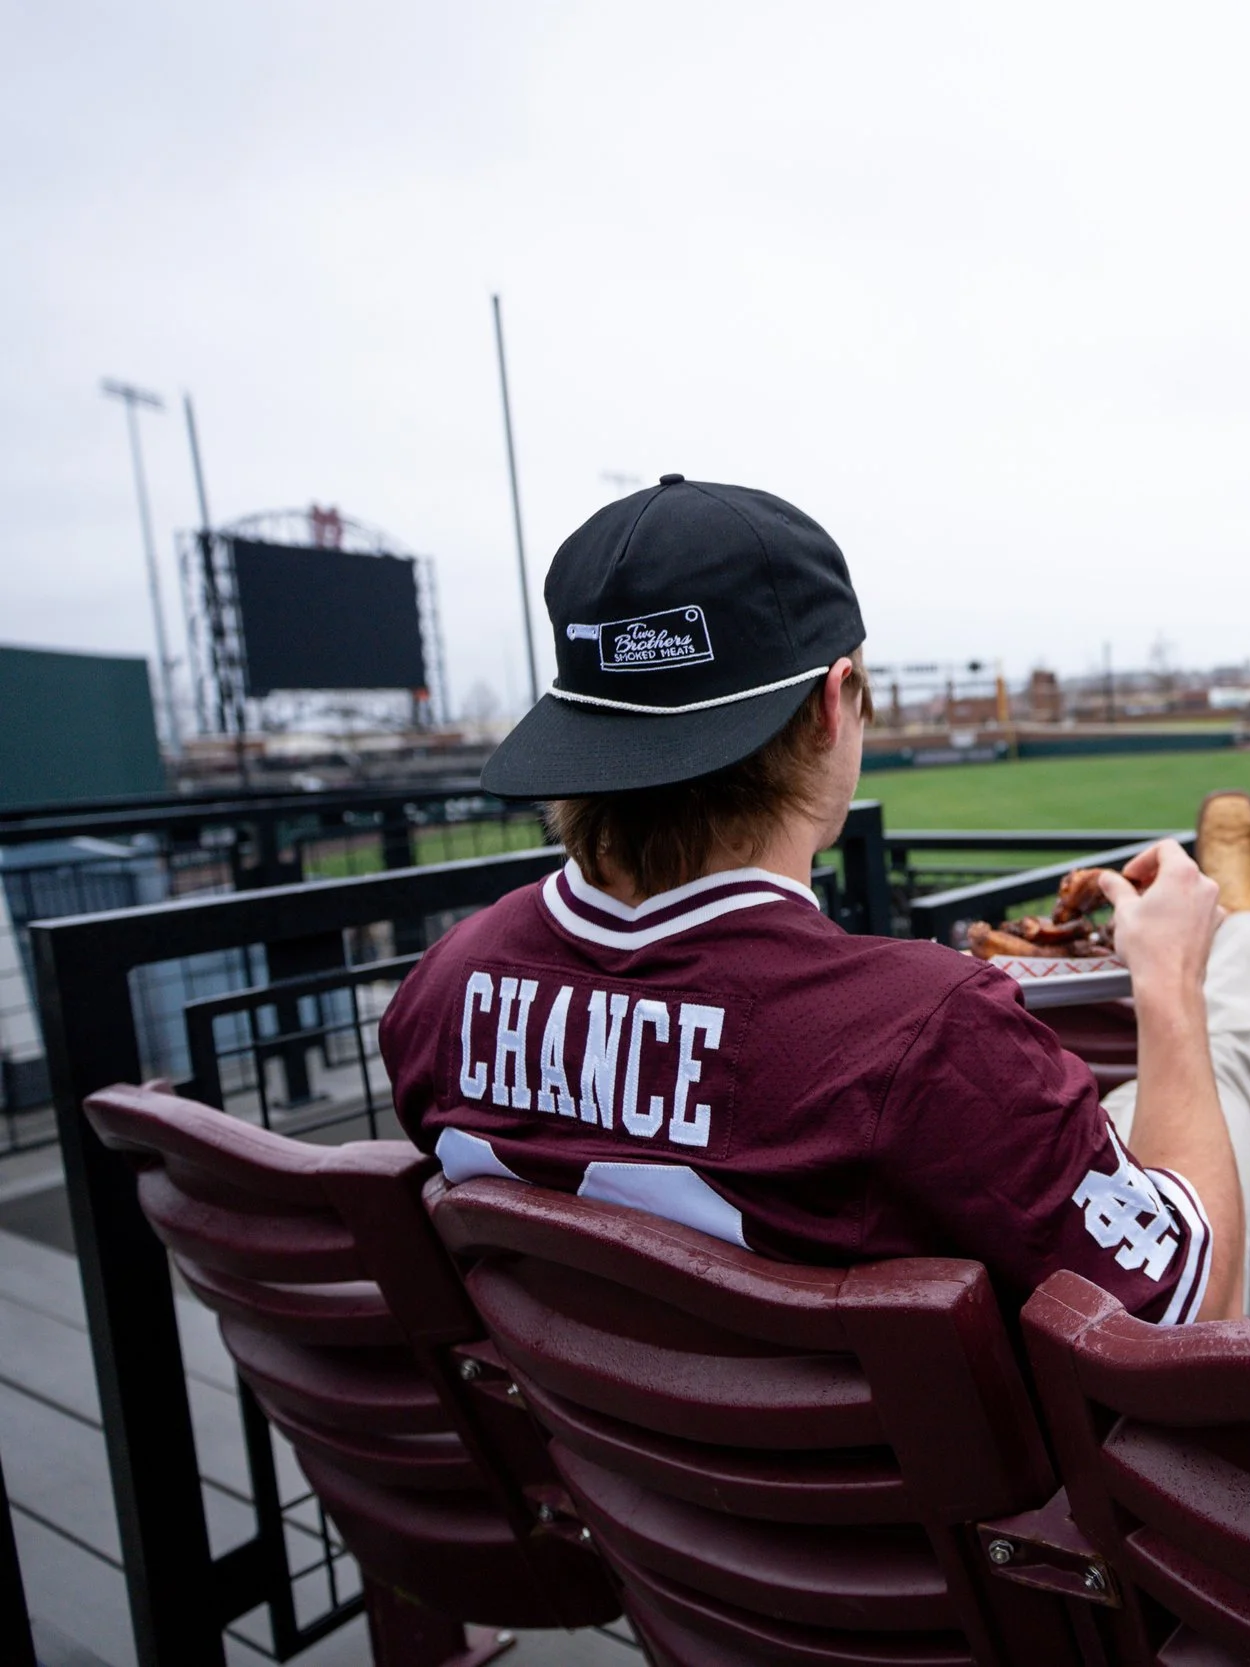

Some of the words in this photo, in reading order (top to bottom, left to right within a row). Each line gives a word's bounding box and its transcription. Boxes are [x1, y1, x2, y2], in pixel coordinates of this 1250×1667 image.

[614, 629, 692, 654] Brothers
[627, 623, 655, 640] Two
[614, 650, 656, 663] SMOKED
[660, 645, 695, 658] MEATS
[459, 970, 725, 1148] CHANCE
